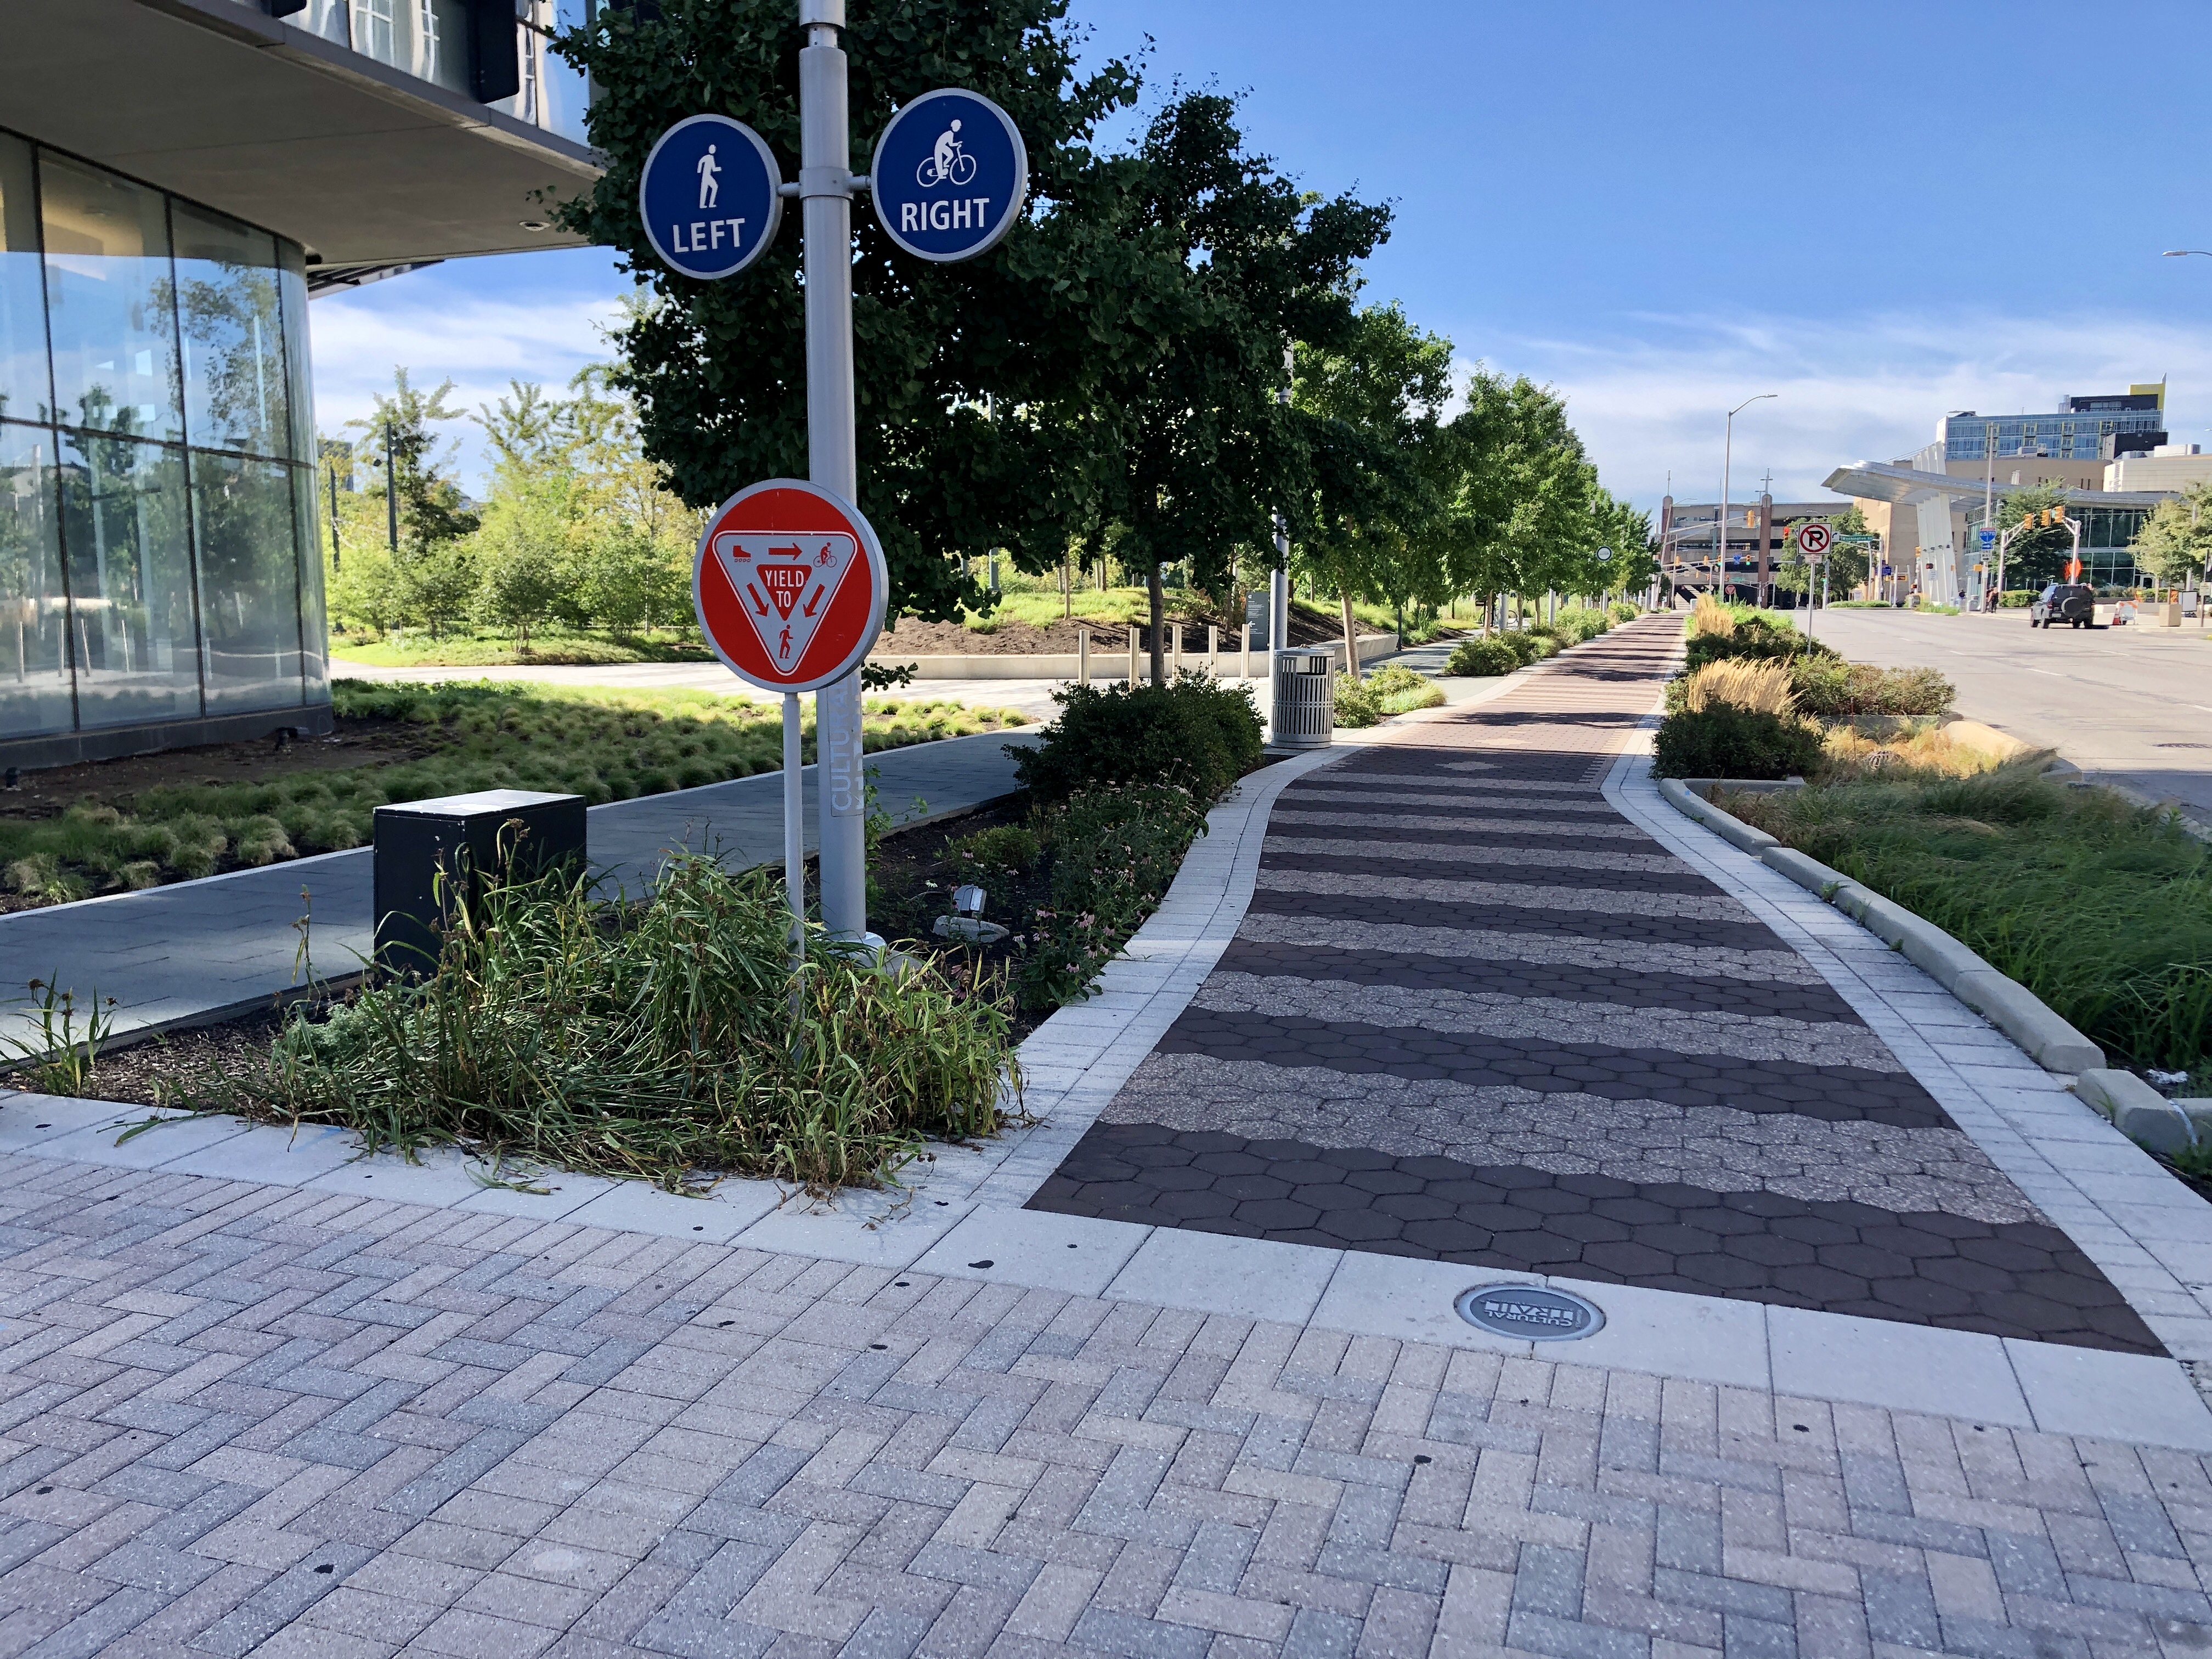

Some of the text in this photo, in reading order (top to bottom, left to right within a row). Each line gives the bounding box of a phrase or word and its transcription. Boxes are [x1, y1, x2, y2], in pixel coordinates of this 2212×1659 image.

[901, 198, 990, 232] RIGHT
[673, 218, 746, 253] LEFT
[765, 570, 805, 588] YIELD
[776, 590, 791, 608] TO
[830, 678, 852, 811] CULTURAL
[1484, 1310, 1572, 1327] CULTURAL
